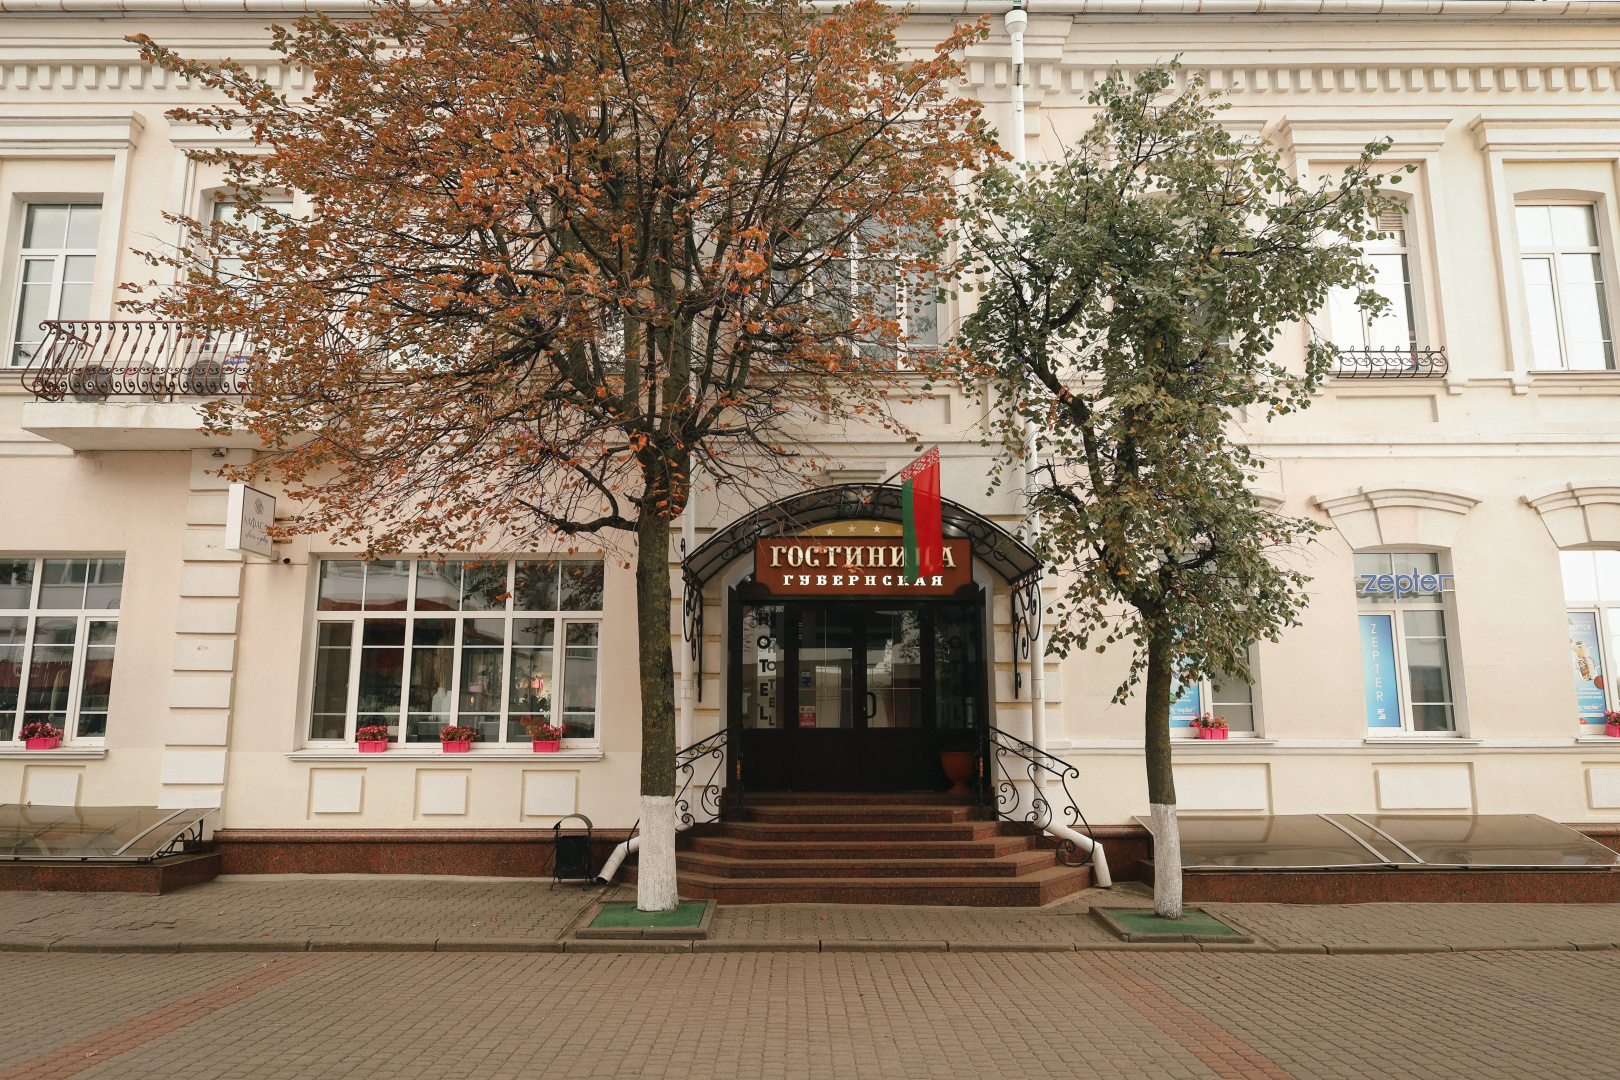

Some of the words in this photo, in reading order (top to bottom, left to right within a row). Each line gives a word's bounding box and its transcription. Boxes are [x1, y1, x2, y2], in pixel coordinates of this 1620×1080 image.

[782, 574, 944, 587] ГУБЕРНСКАЯ
[1360, 567, 1454, 600] zepter
[757, 612, 771, 720] HOTEL
[1370, 623, 1384, 702] ZEPTER
